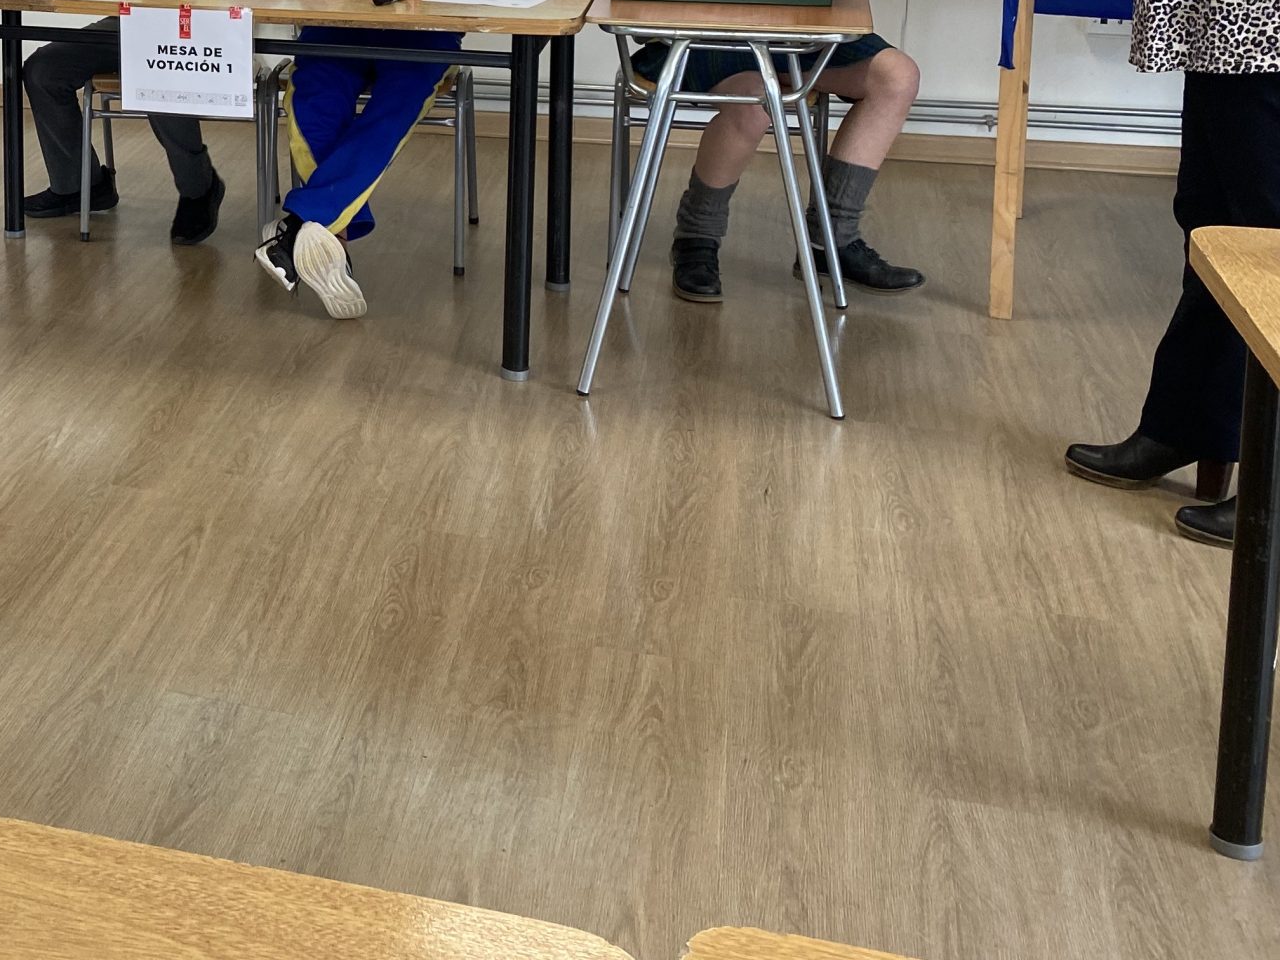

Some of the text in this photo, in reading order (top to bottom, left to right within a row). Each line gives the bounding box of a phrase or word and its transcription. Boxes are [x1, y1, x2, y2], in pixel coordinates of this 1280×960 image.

[157, 44, 222, 57] MESA DE
[146, 59, 233, 73] VOTACIÓN 1
